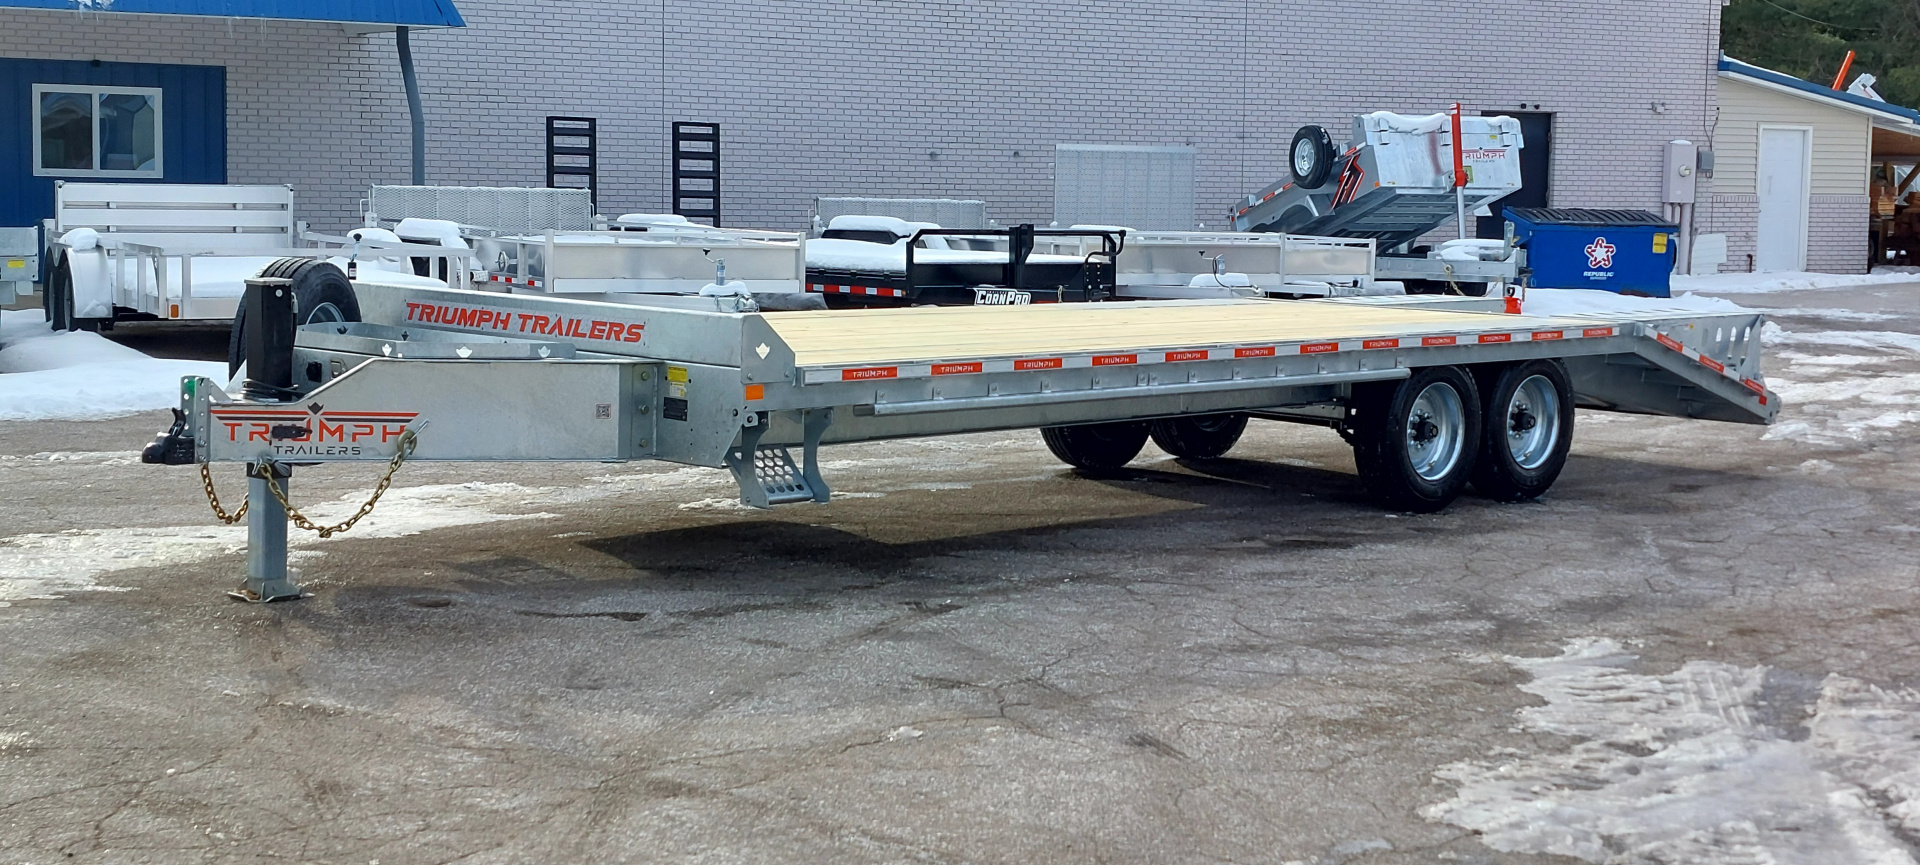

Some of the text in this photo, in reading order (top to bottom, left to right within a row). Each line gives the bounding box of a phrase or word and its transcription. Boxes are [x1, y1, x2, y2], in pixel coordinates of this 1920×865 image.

[1462, 152, 1506, 160] RIUMPH
[405, 302, 646, 343] TRIUMPH TRAILERS
[1100, 356, 1130, 364] TRIUMPH
[1173, 352, 1201, 360] TRIUMPH
[1023, 360, 1054, 368] TRIUMPH
[940, 365, 974, 373] TRIUMPH
[852, 370, 888, 378] TRIUMPH
[273, 444, 361, 456] TRAILERS
